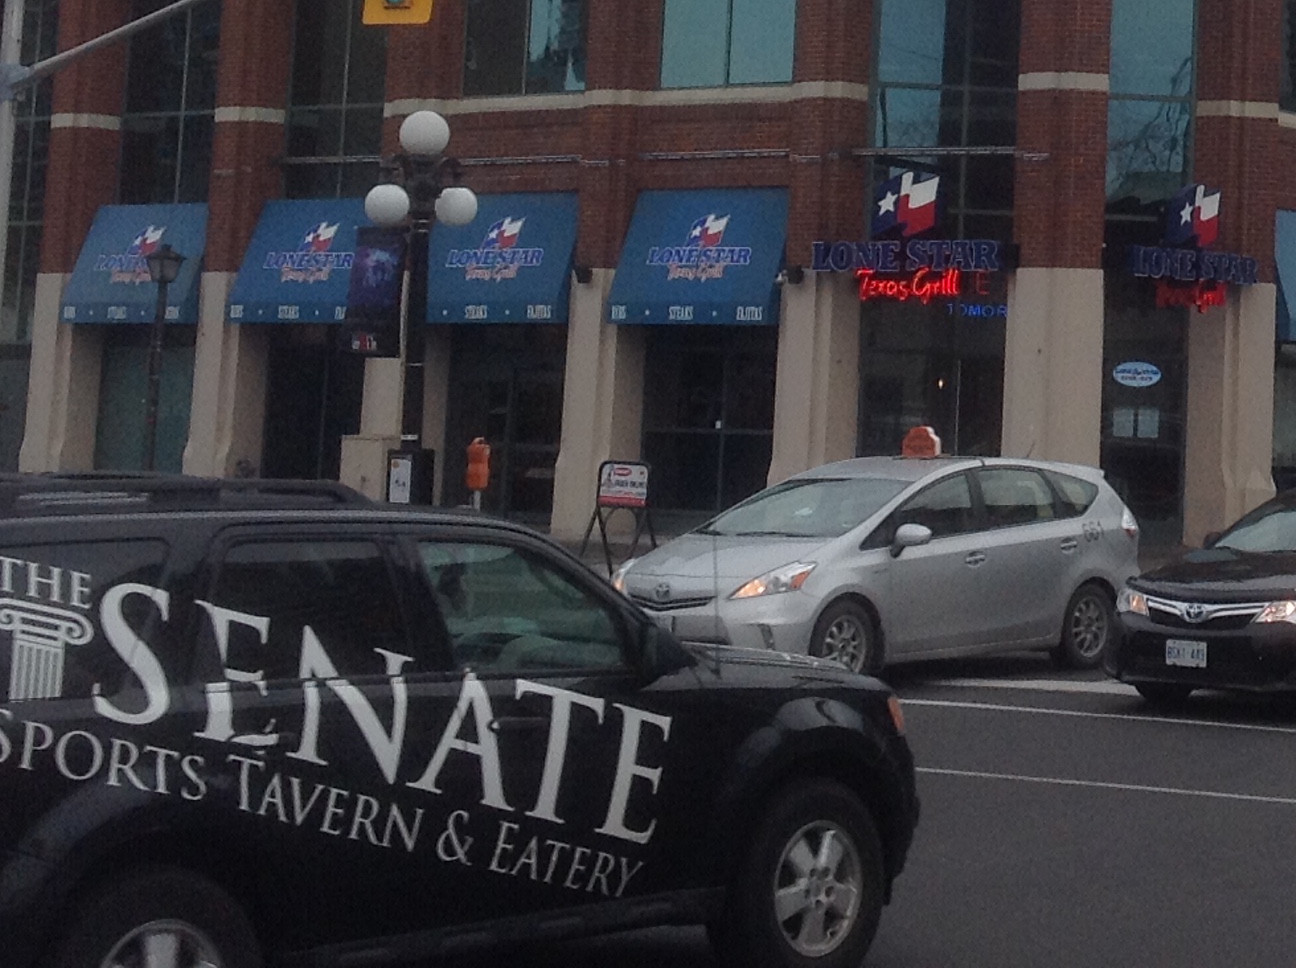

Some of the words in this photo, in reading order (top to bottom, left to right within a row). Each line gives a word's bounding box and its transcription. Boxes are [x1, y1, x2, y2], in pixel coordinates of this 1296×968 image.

[445, 249, 496, 268] LONE
[495, 248, 544, 267] STAR
[646, 247, 698, 265] LONE
[699, 247, 752, 265] STAR
[811, 240, 900, 272] LONE
[905, 239, 999, 272] STAR
[1133, 246, 1197, 280] LONE
[1199, 250, 1258, 285] STAR
[856, 267, 909, 301] Texas
[910, 265, 962, 305] Grill
[0, 556, 93, 609] THE
[93, 582, 673, 845] SENATE
[435, 809, 473, 867] &
